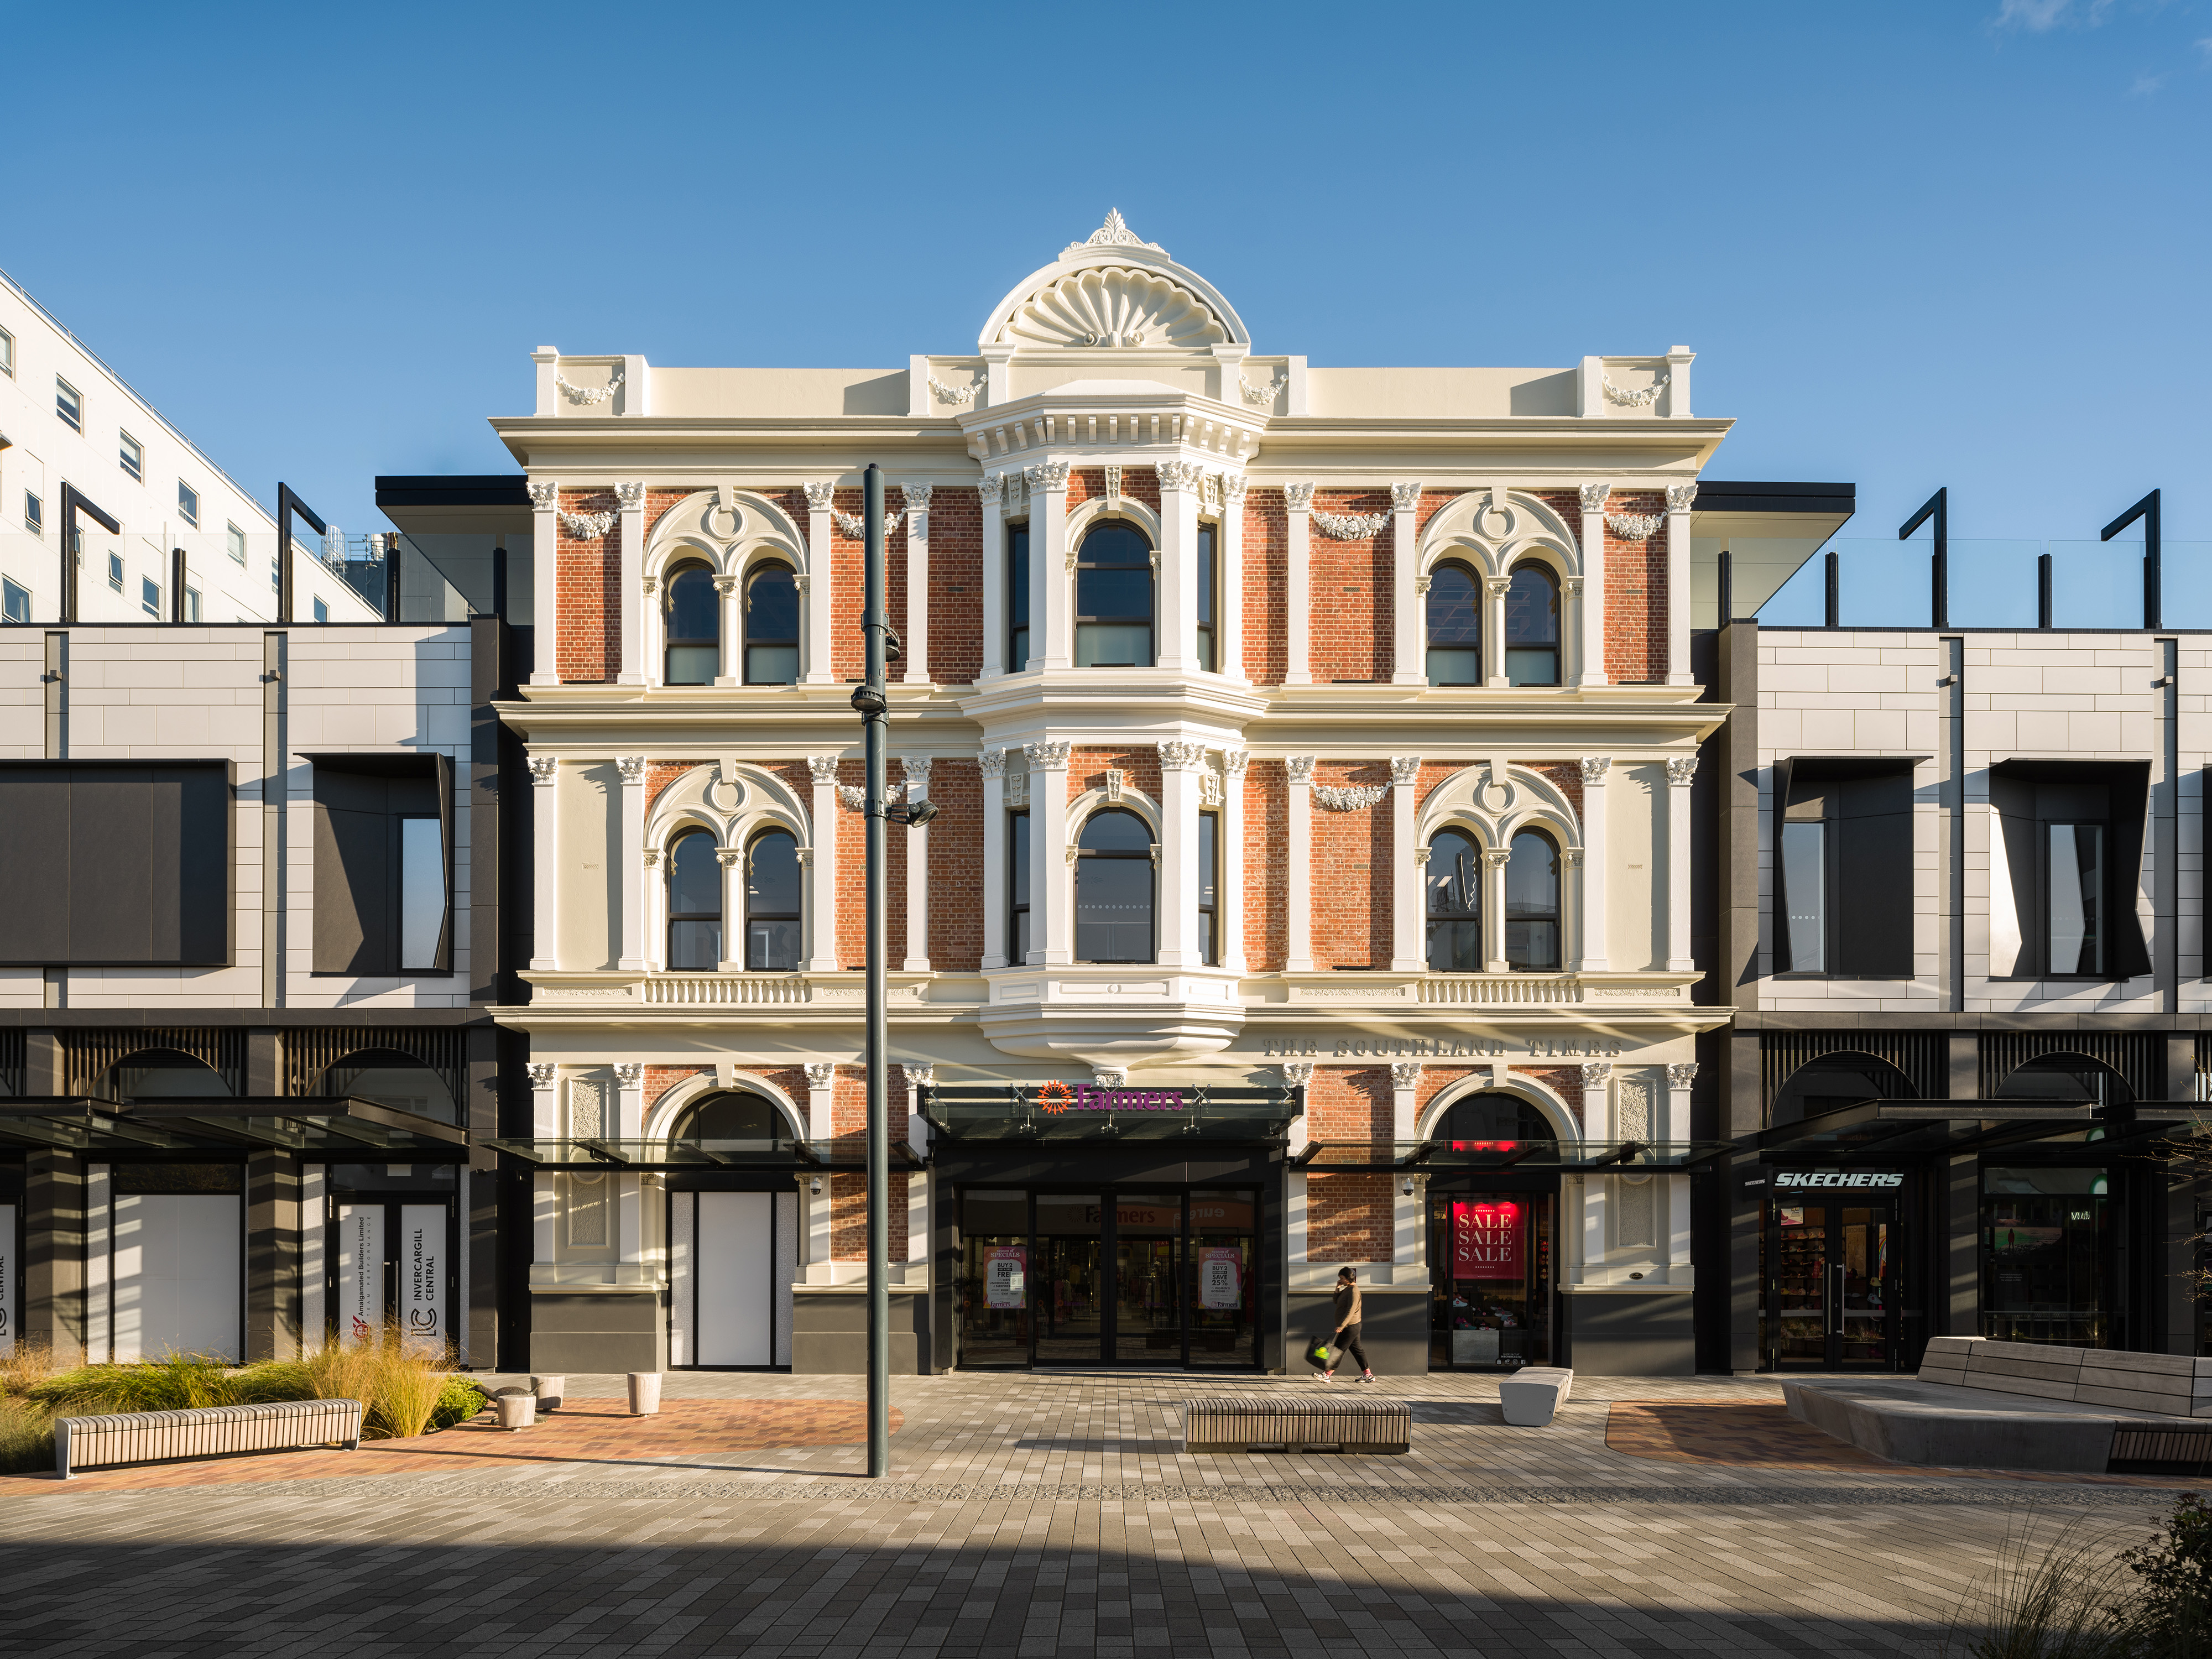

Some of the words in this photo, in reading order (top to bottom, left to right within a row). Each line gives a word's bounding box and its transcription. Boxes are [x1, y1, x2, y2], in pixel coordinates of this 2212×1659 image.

[1264, 1039, 1319, 1058] THE
[1334, 1039, 1508, 1058] SOUTHLAND
[1528, 1039, 1624, 1058] TIMES
[1077, 1083, 1183, 1111] Farmers
[1775, 1173, 1904, 1187] SKECHERS
[1086, 1206, 1155, 1223] Famers
[1459, 1214, 1511, 1228] SALE
[1459, 1230, 1511, 1245] SALE
[1459, 1247, 1511, 1261] SALE
[414, 1228, 422, 1301] INVERCARGILL
[426, 1256, 434, 1301] CENTRAL
